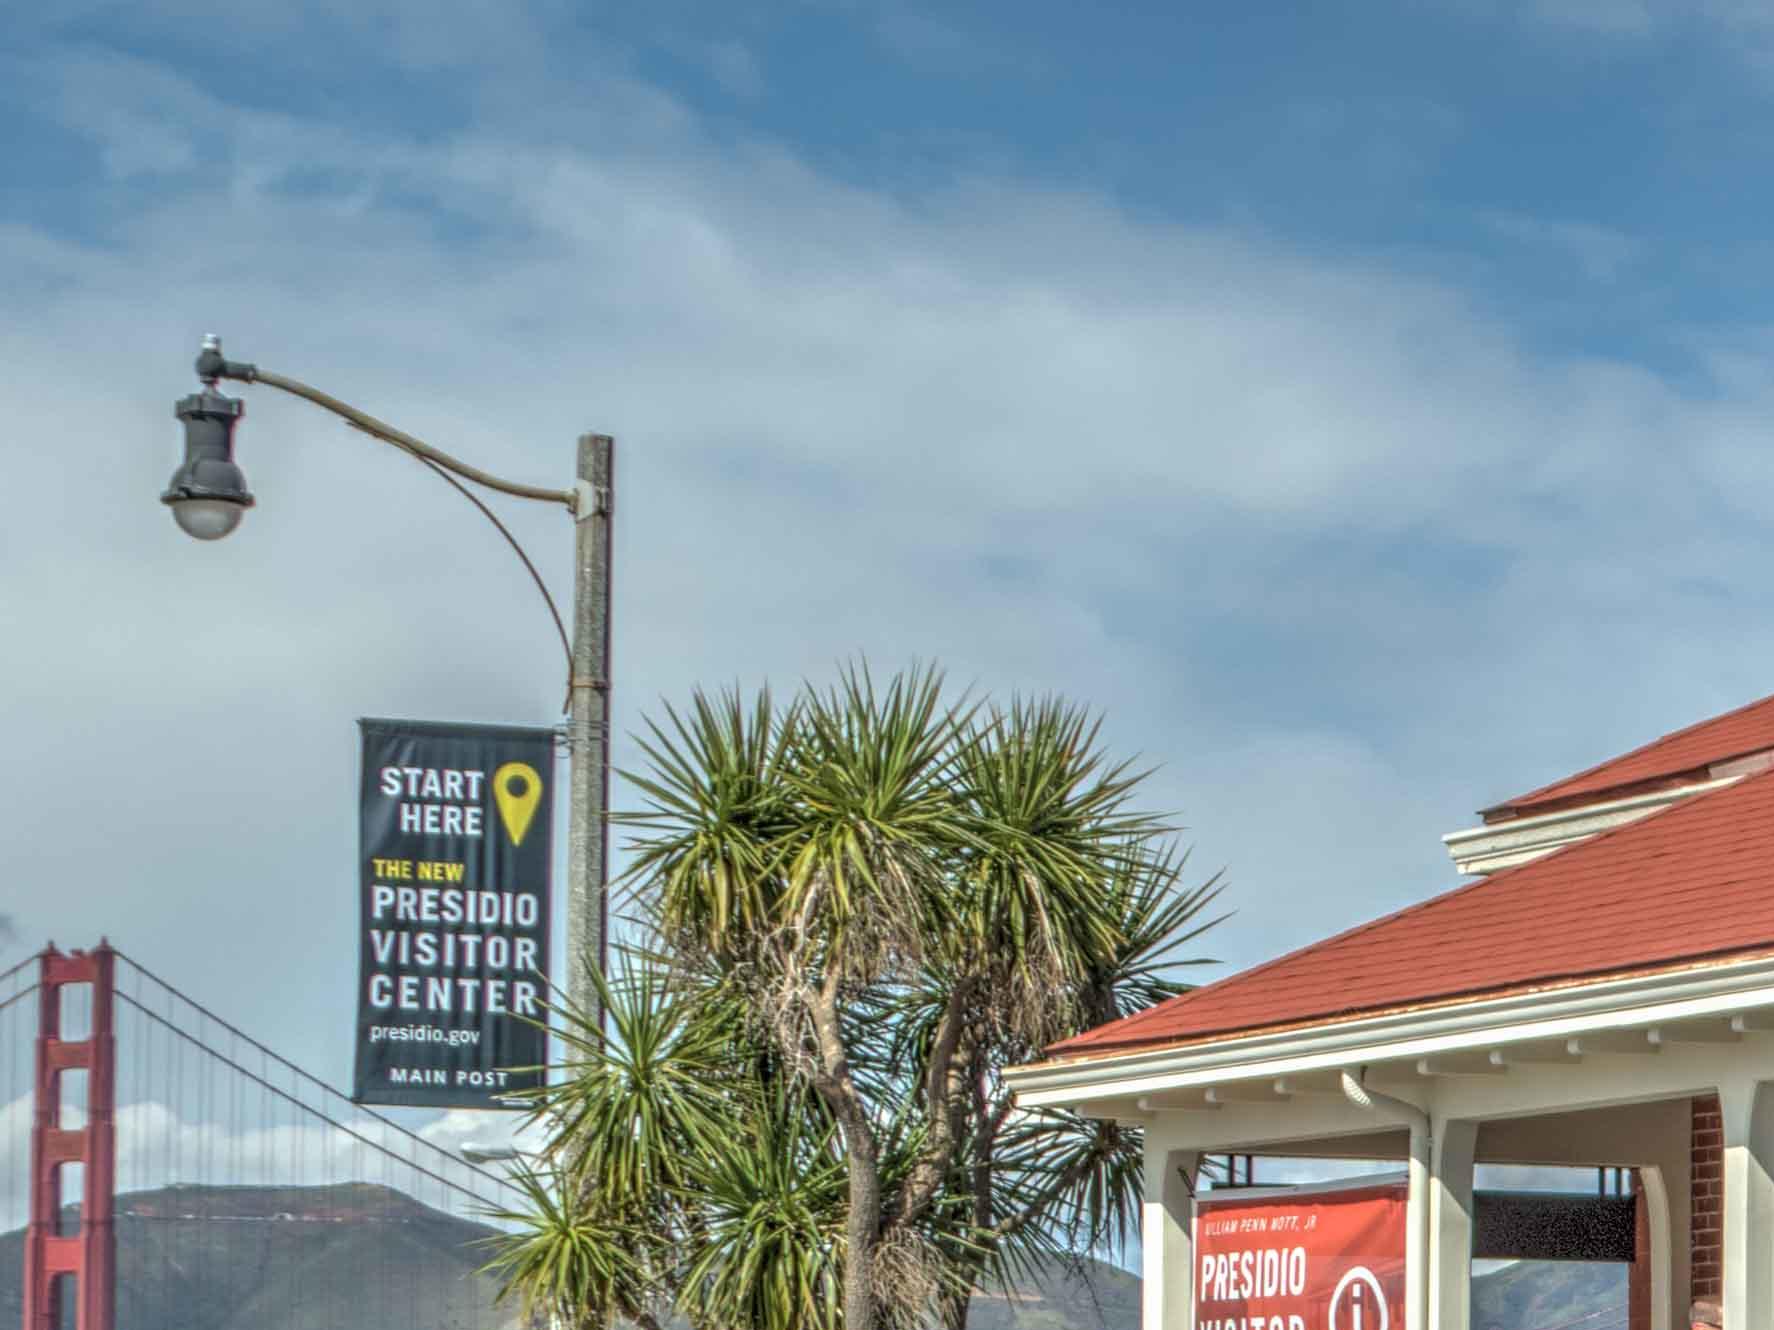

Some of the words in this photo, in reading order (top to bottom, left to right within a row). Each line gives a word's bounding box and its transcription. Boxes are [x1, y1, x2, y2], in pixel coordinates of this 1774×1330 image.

[380, 767, 485, 800] START
[400, 803, 483, 835] HERE
[372, 858, 413, 879] THE
[417, 862, 464, 881] NEW
[372, 885, 538, 926] PRESIDIO
[370, 930, 538, 969] VISITOR
[369, 974, 537, 1014] CENTER
[370, 1024, 481, 1046] presidio.gov
[390, 1068, 447, 1084] MAIN
[456, 1071, 509, 1087] POST
[1239, 1217, 1267, 1233] PENN
[1304, 1215, 1317, 1230] JR
[1201, 1247, 1306, 1301] PRESIDIO
